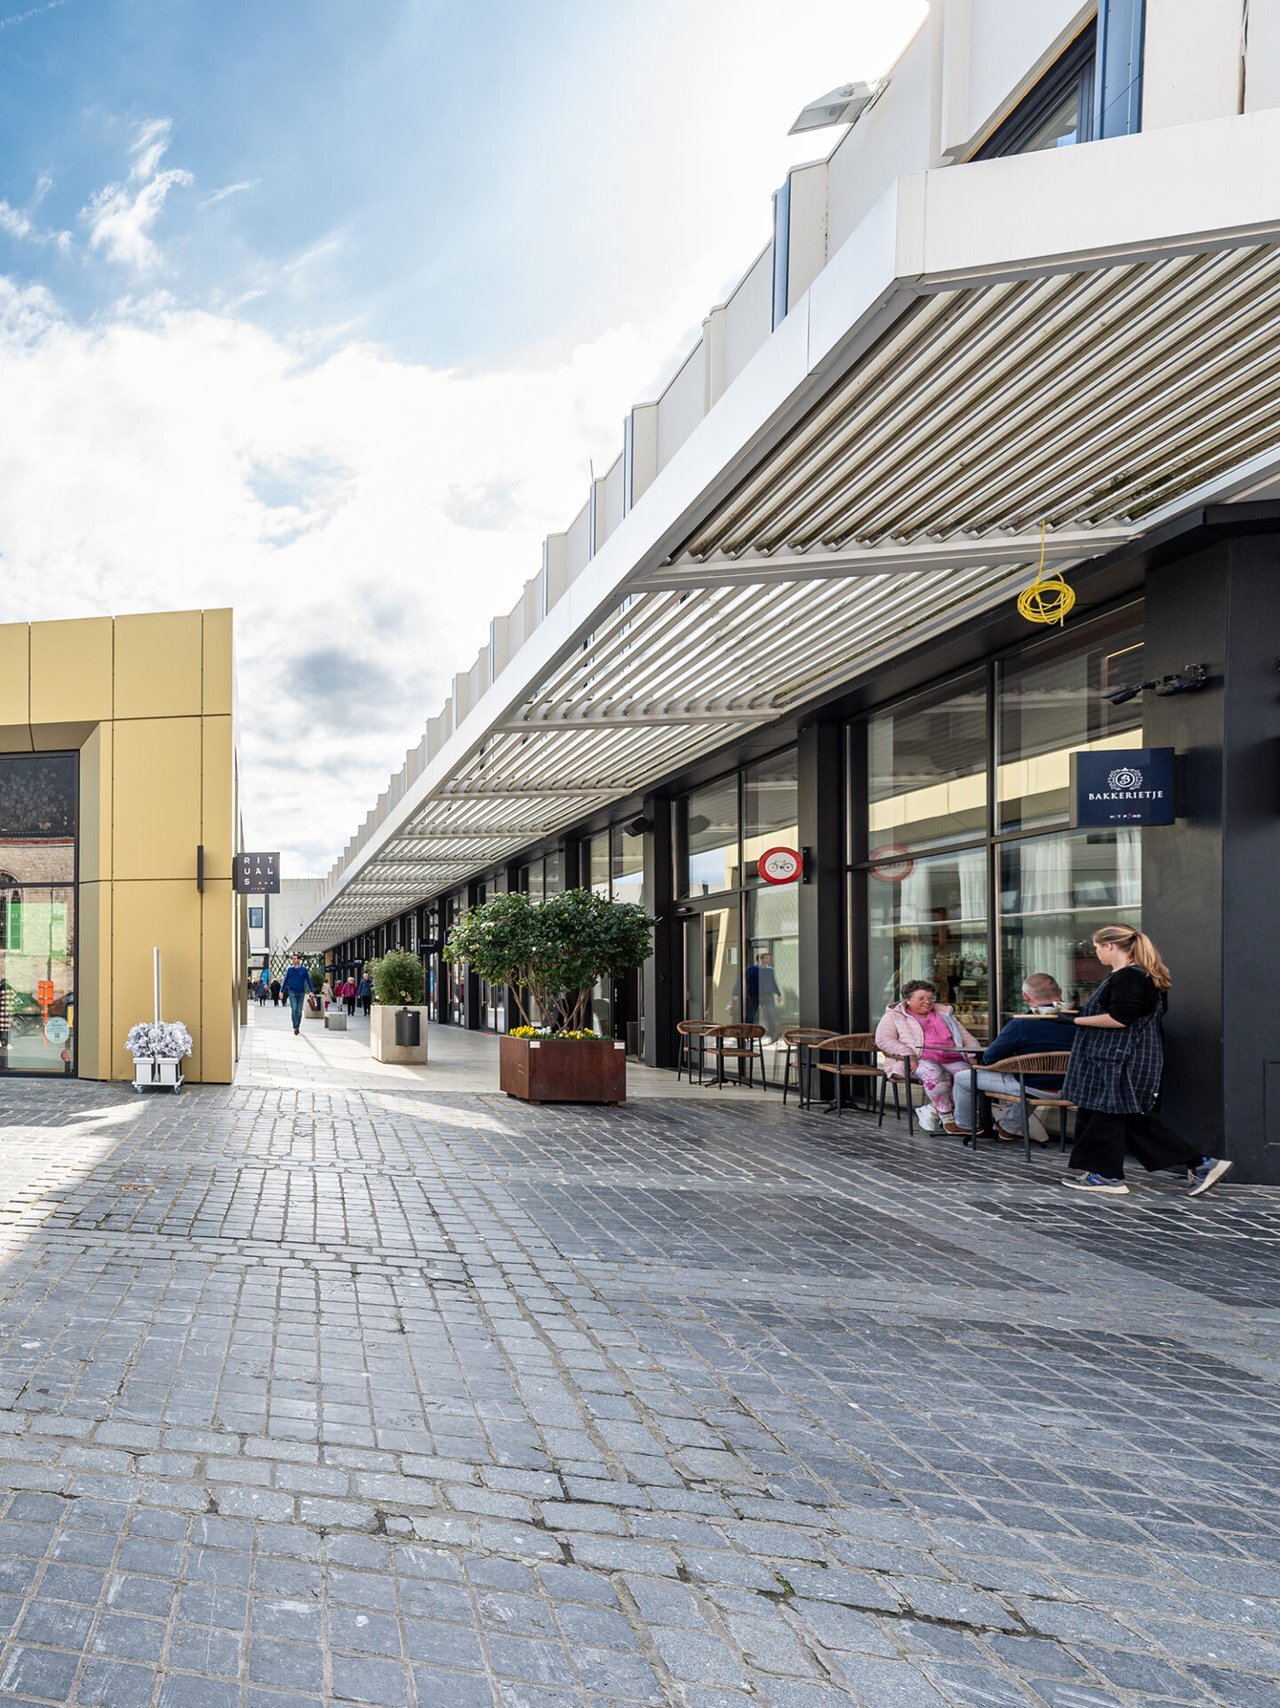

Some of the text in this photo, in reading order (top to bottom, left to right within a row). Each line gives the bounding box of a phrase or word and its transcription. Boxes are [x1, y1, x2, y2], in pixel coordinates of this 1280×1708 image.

[1088, 791, 1164, 801] BAKKERIETJE
[243, 856, 274, 864] RIT
[243, 867, 274, 875] UAL
